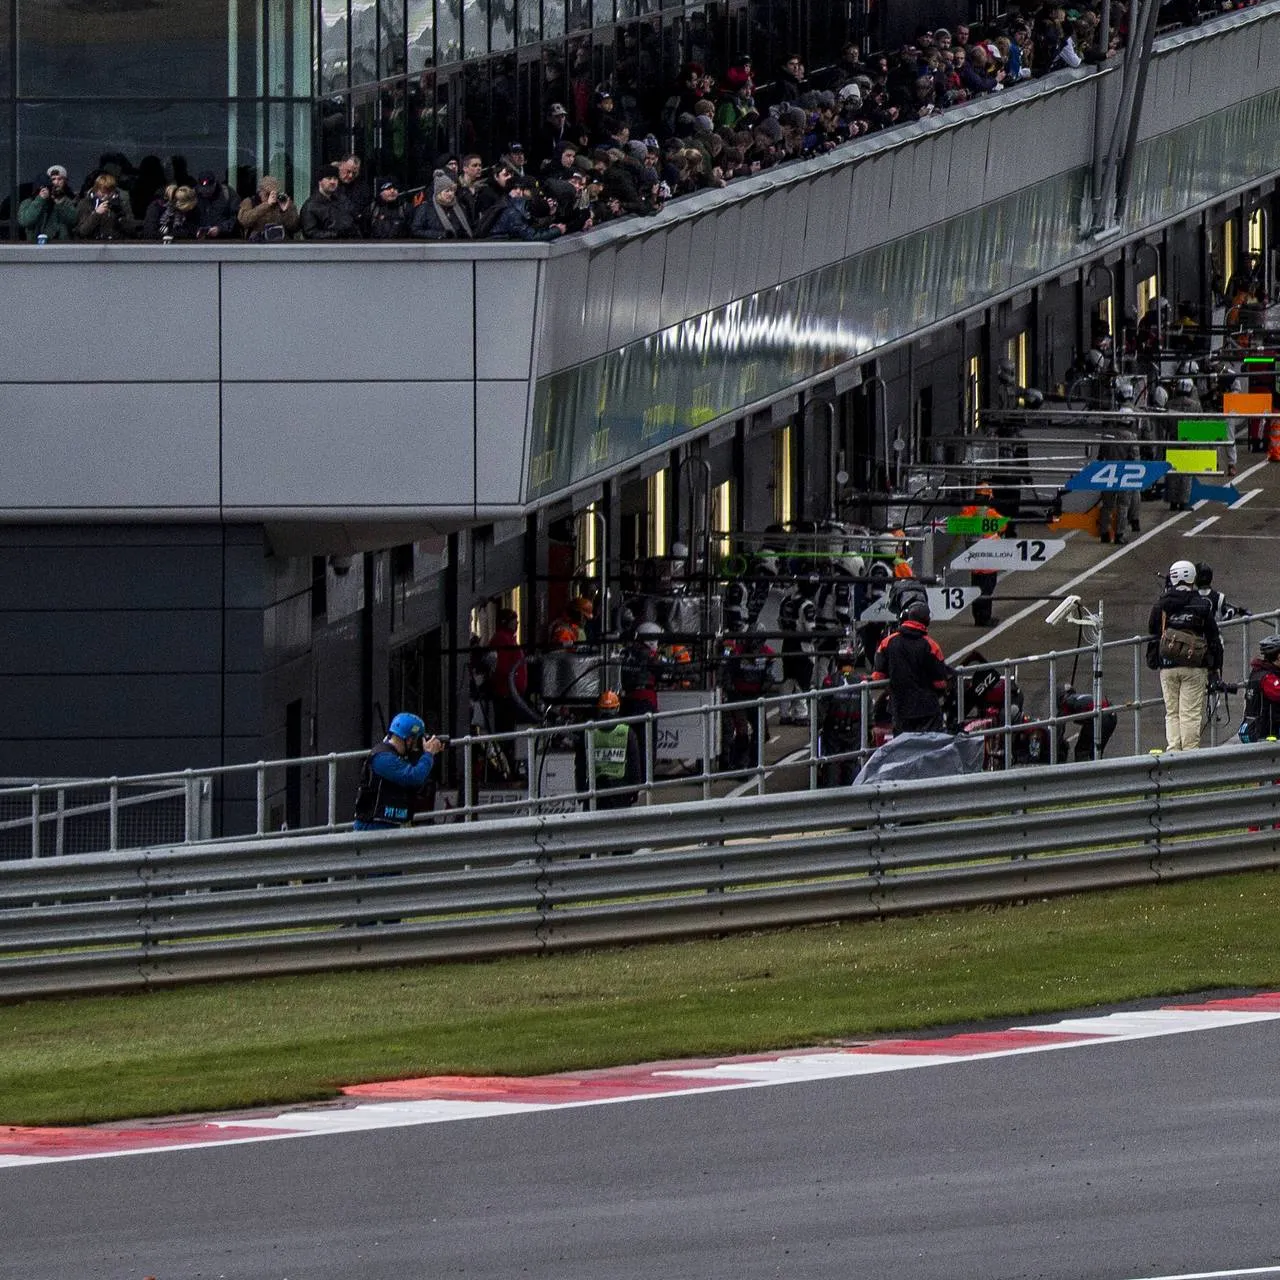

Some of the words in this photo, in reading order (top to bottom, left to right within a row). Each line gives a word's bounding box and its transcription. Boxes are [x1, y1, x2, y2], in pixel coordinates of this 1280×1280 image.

[1090, 463, 1147, 487] 42
[981, 518, 999, 532] 86
[1016, 540, 1046, 561] 12
[941, 588, 965, 610] 13
[974, 673, 997, 697] SYZ
[603, 749, 625, 757] LANE
